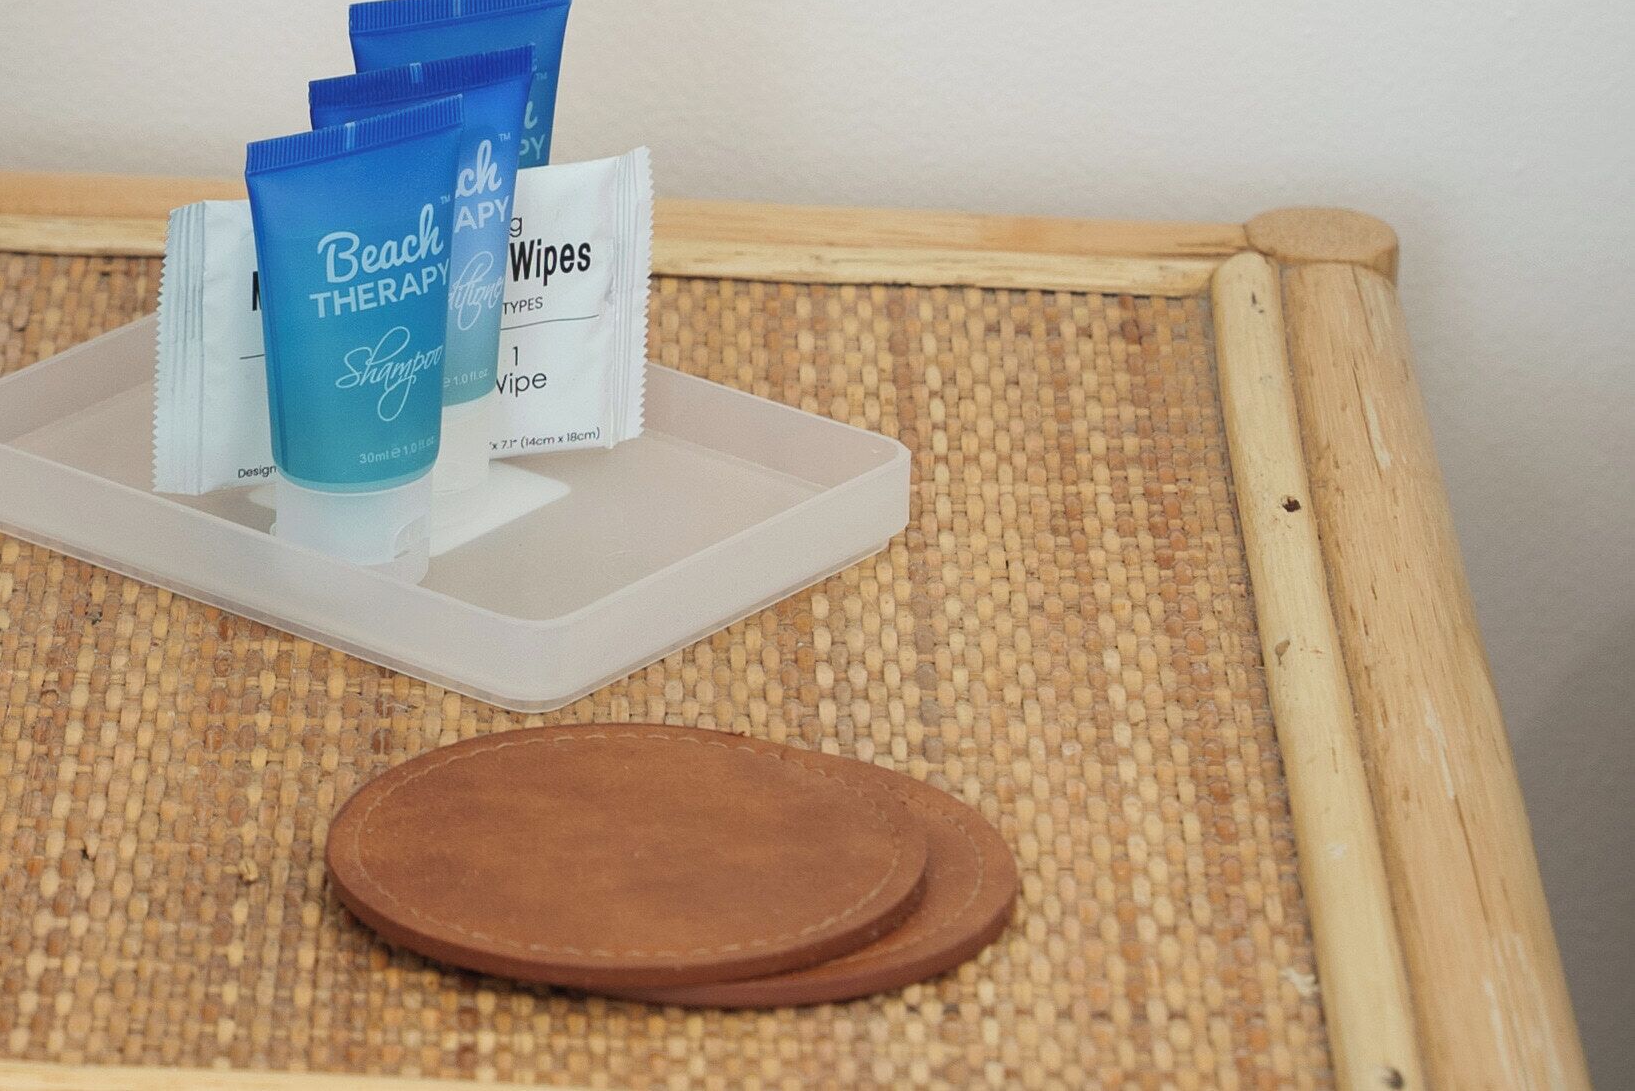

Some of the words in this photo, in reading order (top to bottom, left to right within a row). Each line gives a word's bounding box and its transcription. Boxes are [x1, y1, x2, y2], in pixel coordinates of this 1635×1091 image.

[317, 203, 444, 284] Beach
[509, 237, 591, 287] Wipes
[308, 258, 450, 319] THERAPY
[502, 296, 544, 316] TYPES
[512, 345, 519, 366] 1
[335, 325, 444, 422] Shampoo
[520, 435, 555, 450] (14cm
[557, 436, 564, 444] x
[566, 426, 601, 443] 18cm)
[358, 449, 390, 464] 30ml
[237, 464, 277, 479] Design
